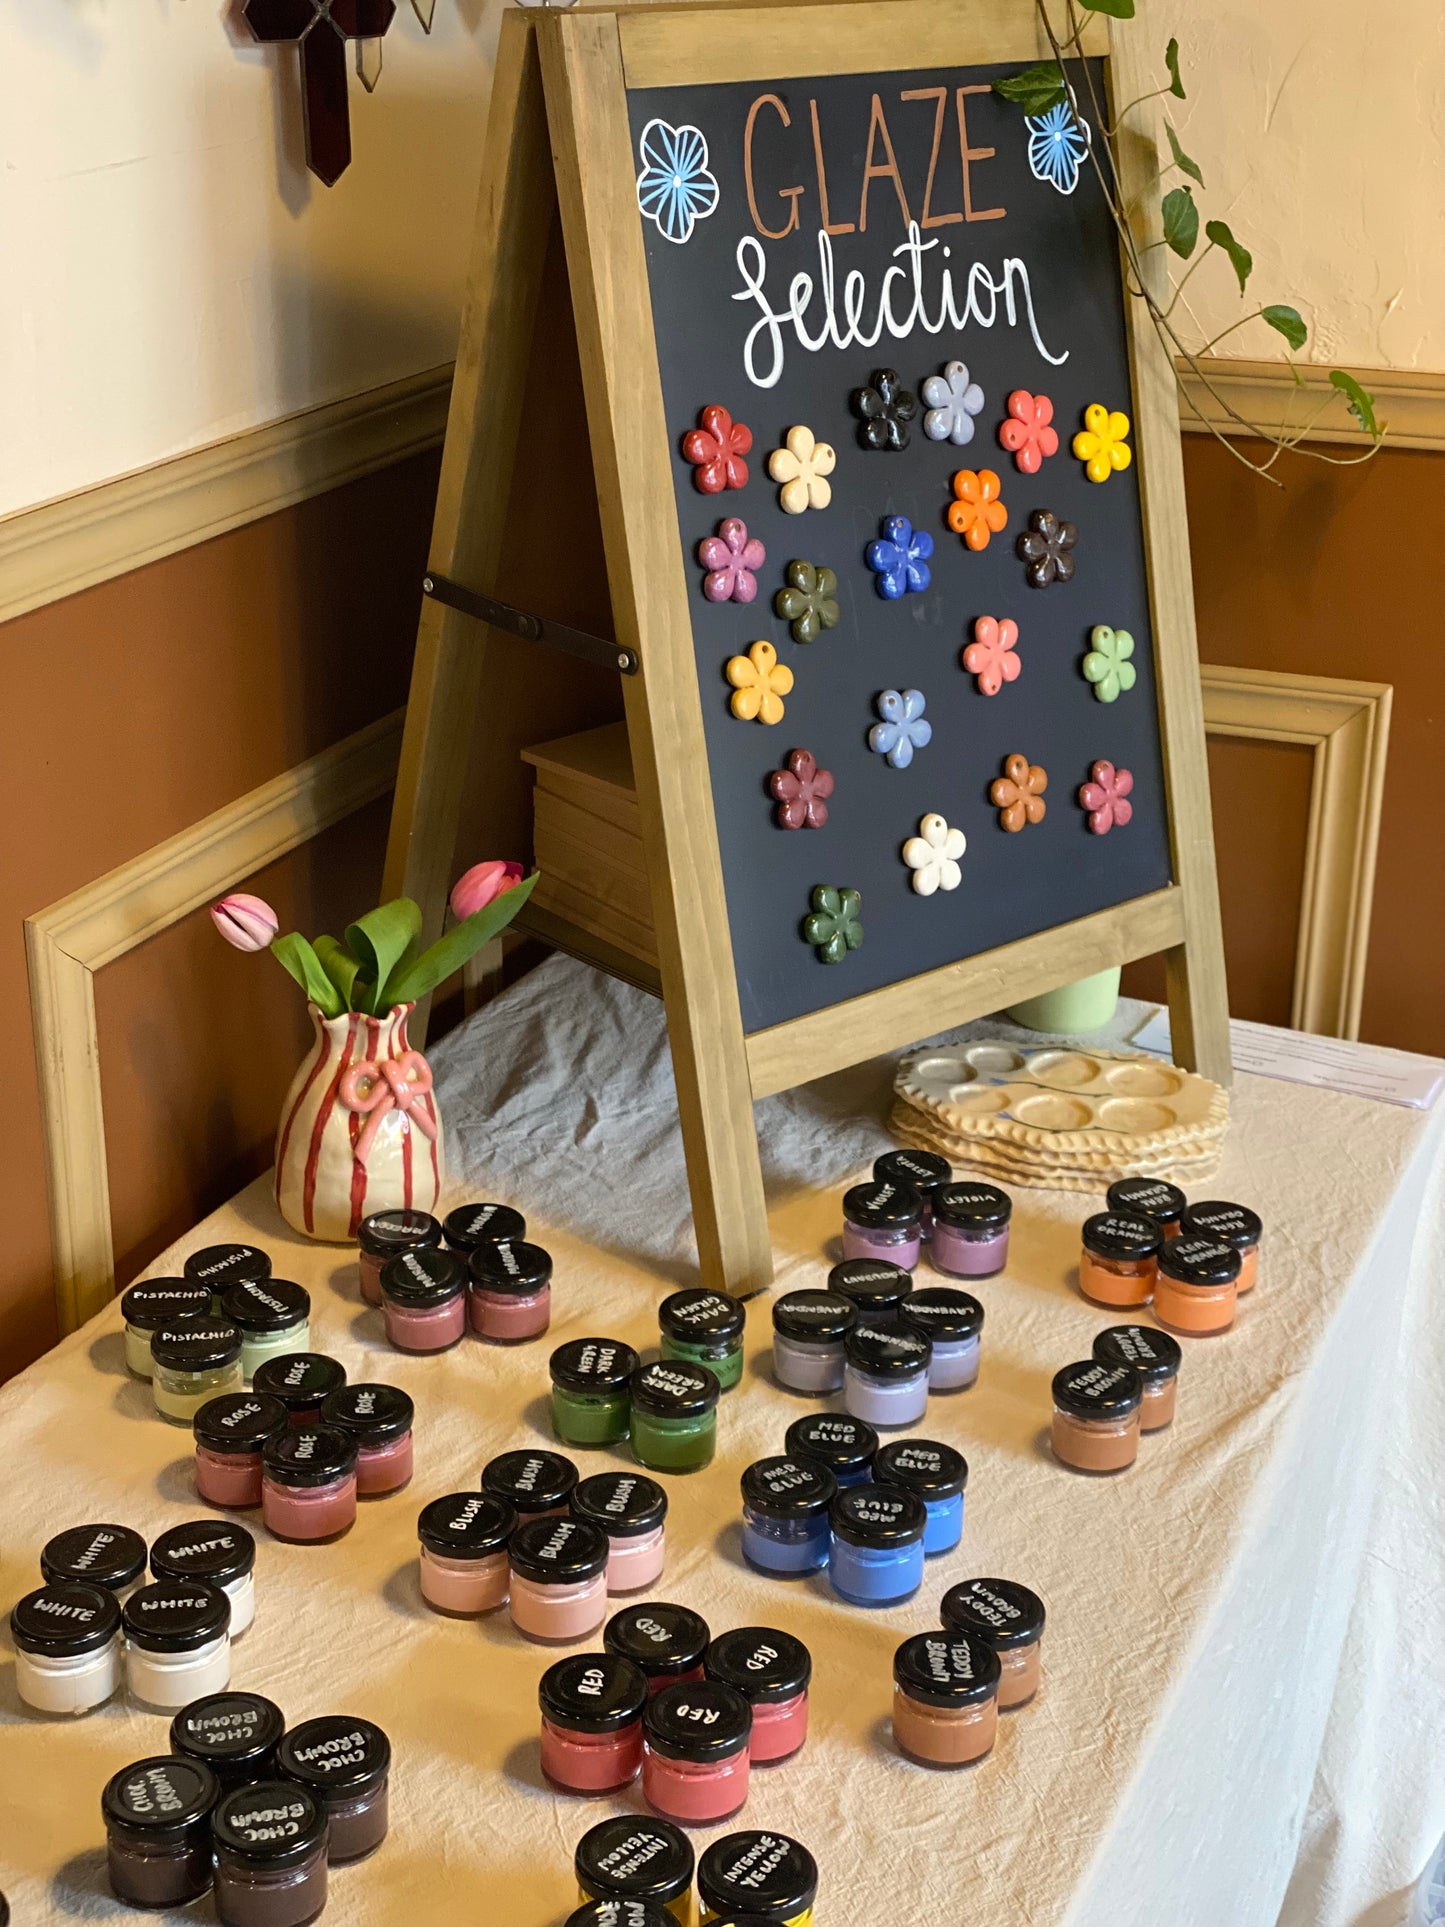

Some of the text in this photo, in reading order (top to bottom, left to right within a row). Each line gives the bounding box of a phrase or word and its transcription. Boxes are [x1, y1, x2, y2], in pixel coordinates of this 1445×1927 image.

[744, 85, 1006, 239] GLAZE
[732, 220, 1069, 388] Selection
[896, 1156, 936, 1178] VIOLET
[866, 1183, 896, 1210] VIOLET
[945, 1194, 996, 1205] VIOLET
[1106, 1218, 1145, 1232] REAL
[1176, 1240, 1214, 1254] REAL
[133, 1290, 208, 1299] PISTACHIO
[673, 1296, 721, 1317] GREEN
[684, 1305, 729, 1324] DARK
[162, 1329, 235, 1342] PISTACHIO
[1112, 1333, 1140, 1361] TEDDY
[577, 1345, 597, 1374] GREEN
[596, 1348, 616, 1374] DARK
[285, 1361, 311, 1385] ROSE
[651, 1365, 705, 1390] GREEN
[1068, 1366, 1108, 1390] TEDDY
[641, 1375, 689, 1397] DARK
[221, 1402, 262, 1427] ROSE
[355, 1391, 376, 1415] ROSE
[809, 1431, 855, 1444] BLUE
[819, 1421, 856, 1433] MED
[295, 1434, 317, 1459] ROSE
[902, 1449, 941, 1461] MED
[895, 1457, 942, 1472] BLUE
[769, 1471, 814, 1493] BLUE
[853, 1498, 904, 1513] BLUE
[858, 1510, 897, 1523] MED
[71, 1532, 114, 1570] WHITE
[168, 1536, 235, 1559] WHITE
[33, 1599, 96, 1622] WHITE
[141, 1598, 208, 1610] WHITE
[959, 1595, 1007, 1627] TEDDY
[635, 1617, 672, 1642] RED
[746, 1644, 779, 1670] RED
[950, 1639, 975, 1679] TEDDY
[577, 1668, 605, 1696] RED
[187, 1710, 258, 1731] BROWN
[676, 1704, 720, 1725] RED
[317, 1749, 365, 1772] CHOC
[146, 1767, 184, 1811] BROWN
[597, 1832, 655, 1871] YELLOW
[611, 1838, 669, 1880] INTENSE
[723, 1835, 777, 1883] INTENSE
[740, 1838, 791, 1888] YELLOW
